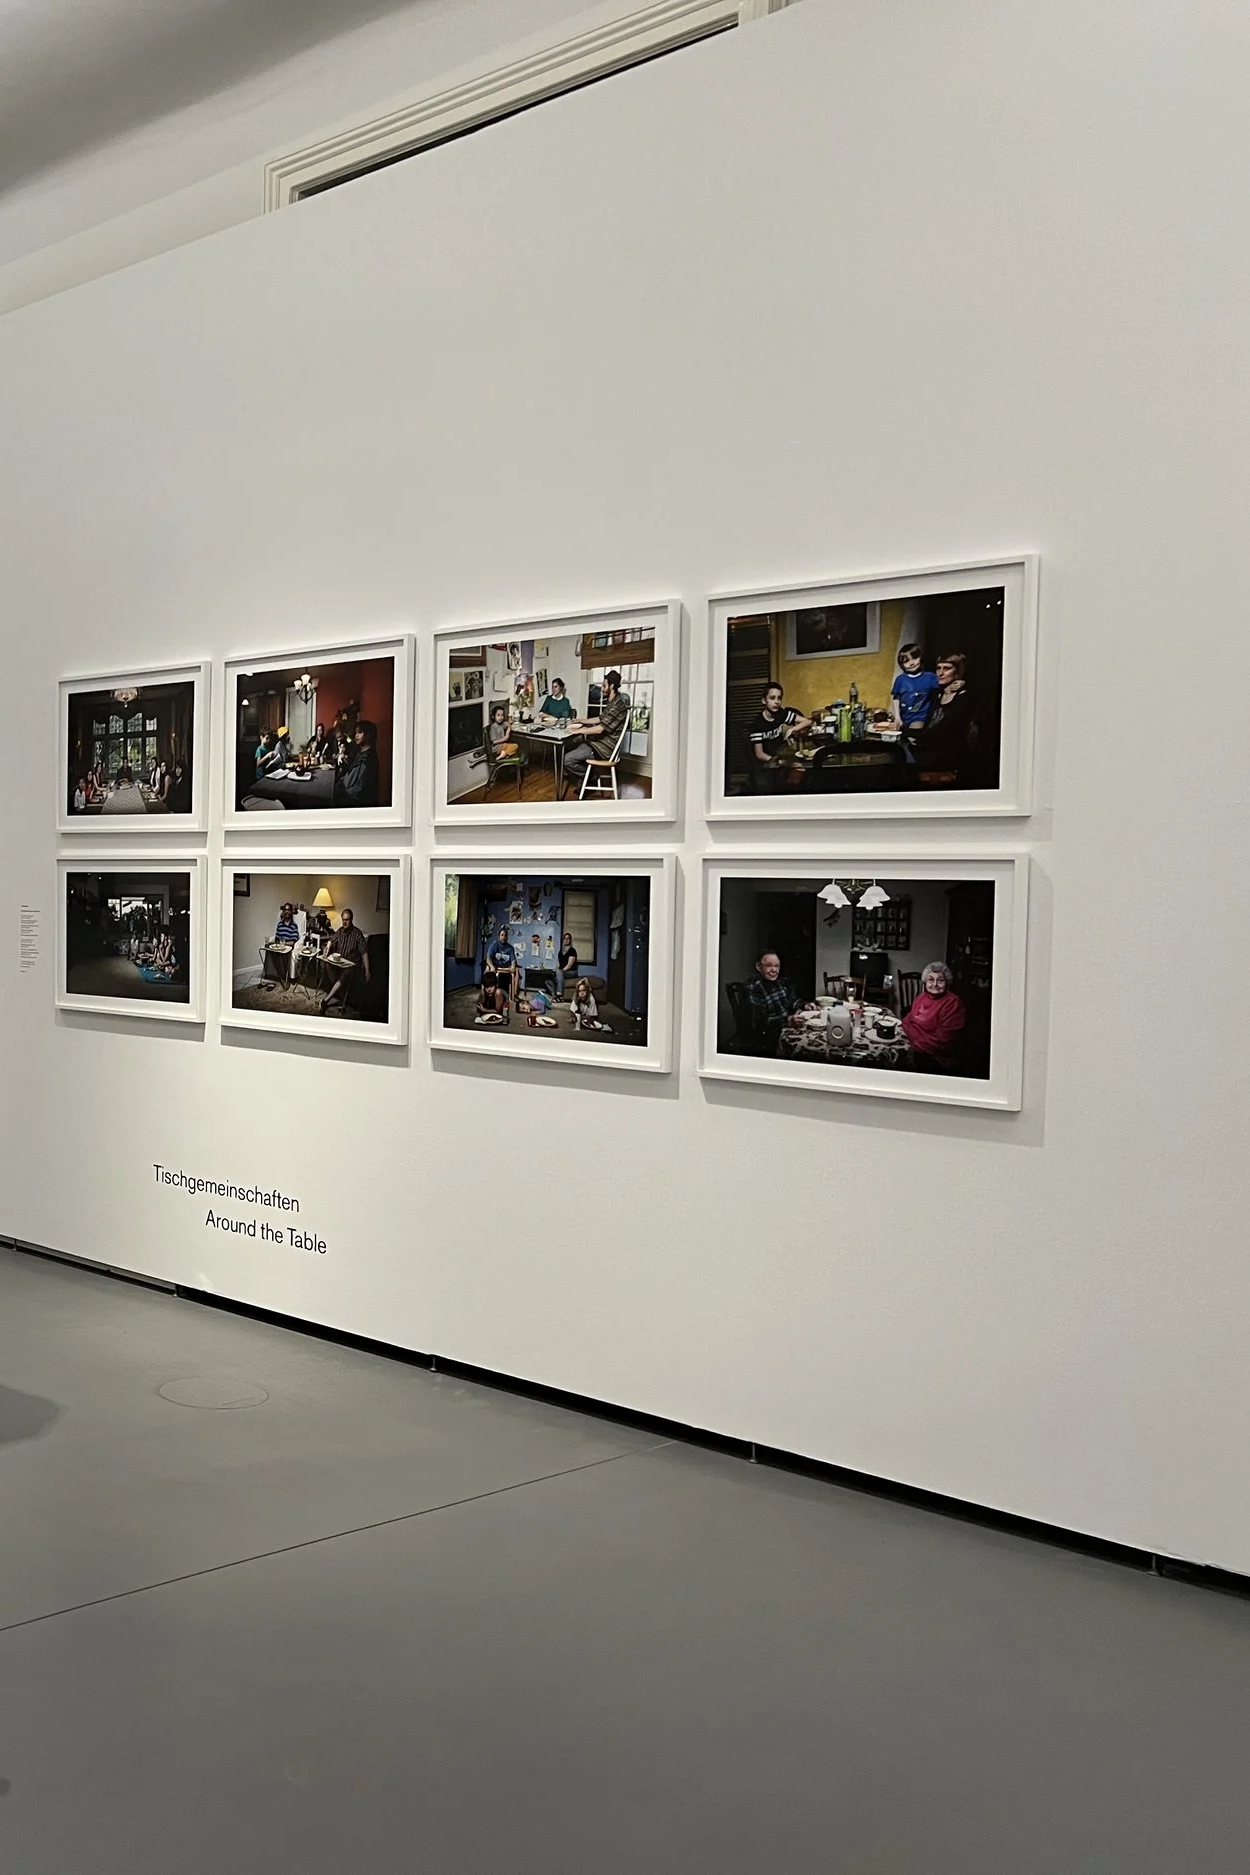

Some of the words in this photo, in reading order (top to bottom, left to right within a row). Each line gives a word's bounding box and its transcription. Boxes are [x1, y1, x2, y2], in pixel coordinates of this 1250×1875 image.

[153, 1164, 300, 1212] Tischgemeinschaften
[205, 1209, 256, 1237] Around
[261, 1223, 283, 1244] the
[287, 1227, 327, 1254] Table
